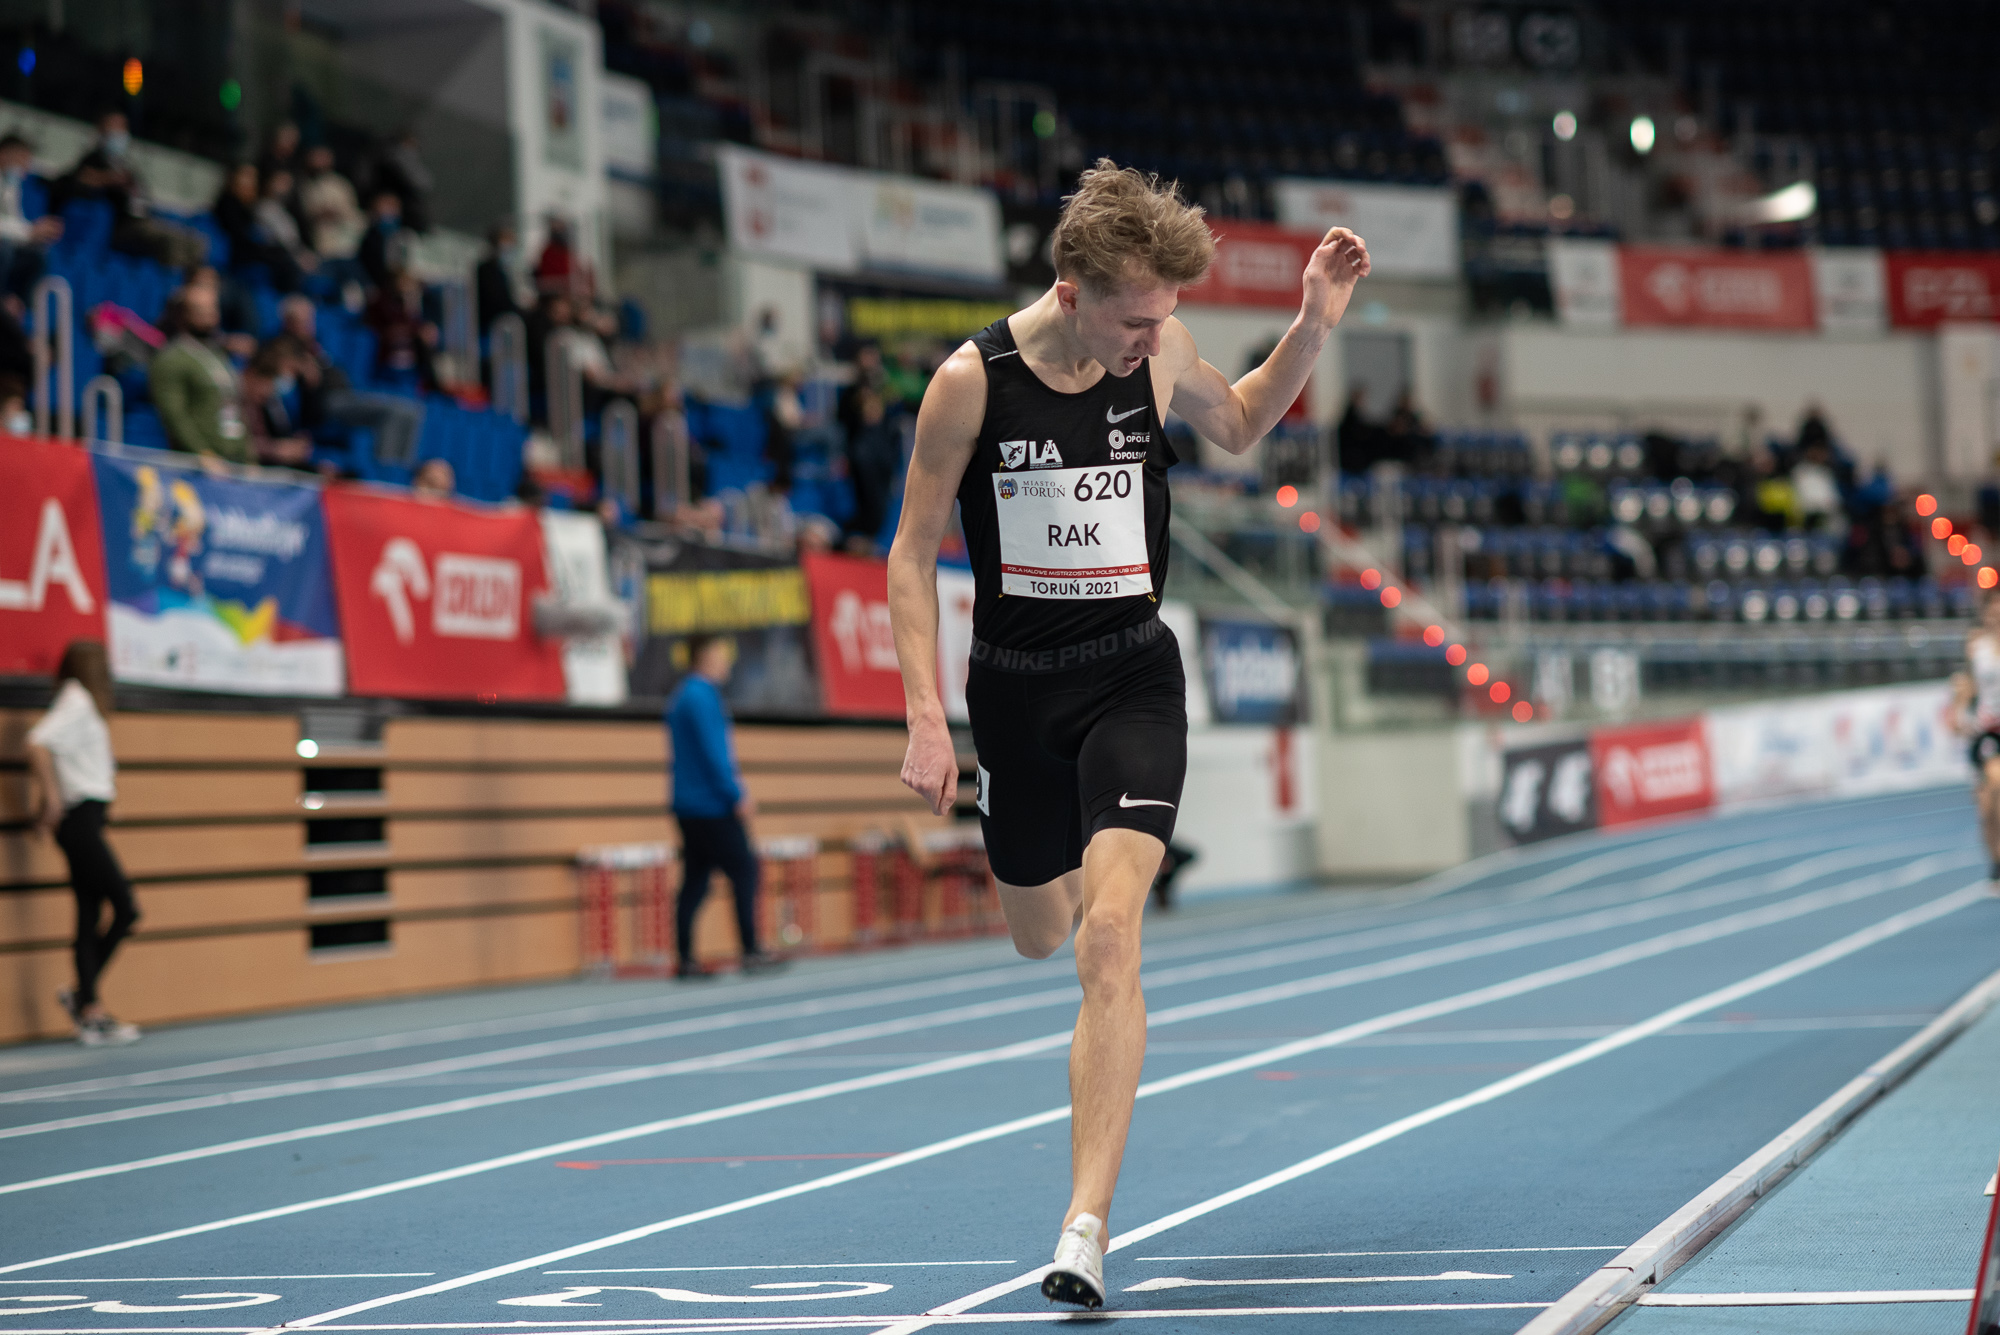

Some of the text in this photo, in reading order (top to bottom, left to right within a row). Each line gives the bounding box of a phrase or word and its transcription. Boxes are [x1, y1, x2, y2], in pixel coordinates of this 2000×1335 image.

[1126, 435, 1150, 443] OPOLE
[1029, 440, 1063, 464] LA
[1021, 485, 1066, 498] TORUŃ
[1074, 470, 1131, 502] 620
[1048, 522, 1101, 547] RAK
[0, 497, 95, 615] A
[1023, 568, 1048, 576] HALOWE
[1095, 568, 1118, 576] POLSKI
[1130, 565, 1143, 573] U20
[1030, 579, 1119, 595] TORUŃ 2021
[992, 648, 1054, 671] NIKE
[1059, 632, 1118, 668] PRO
